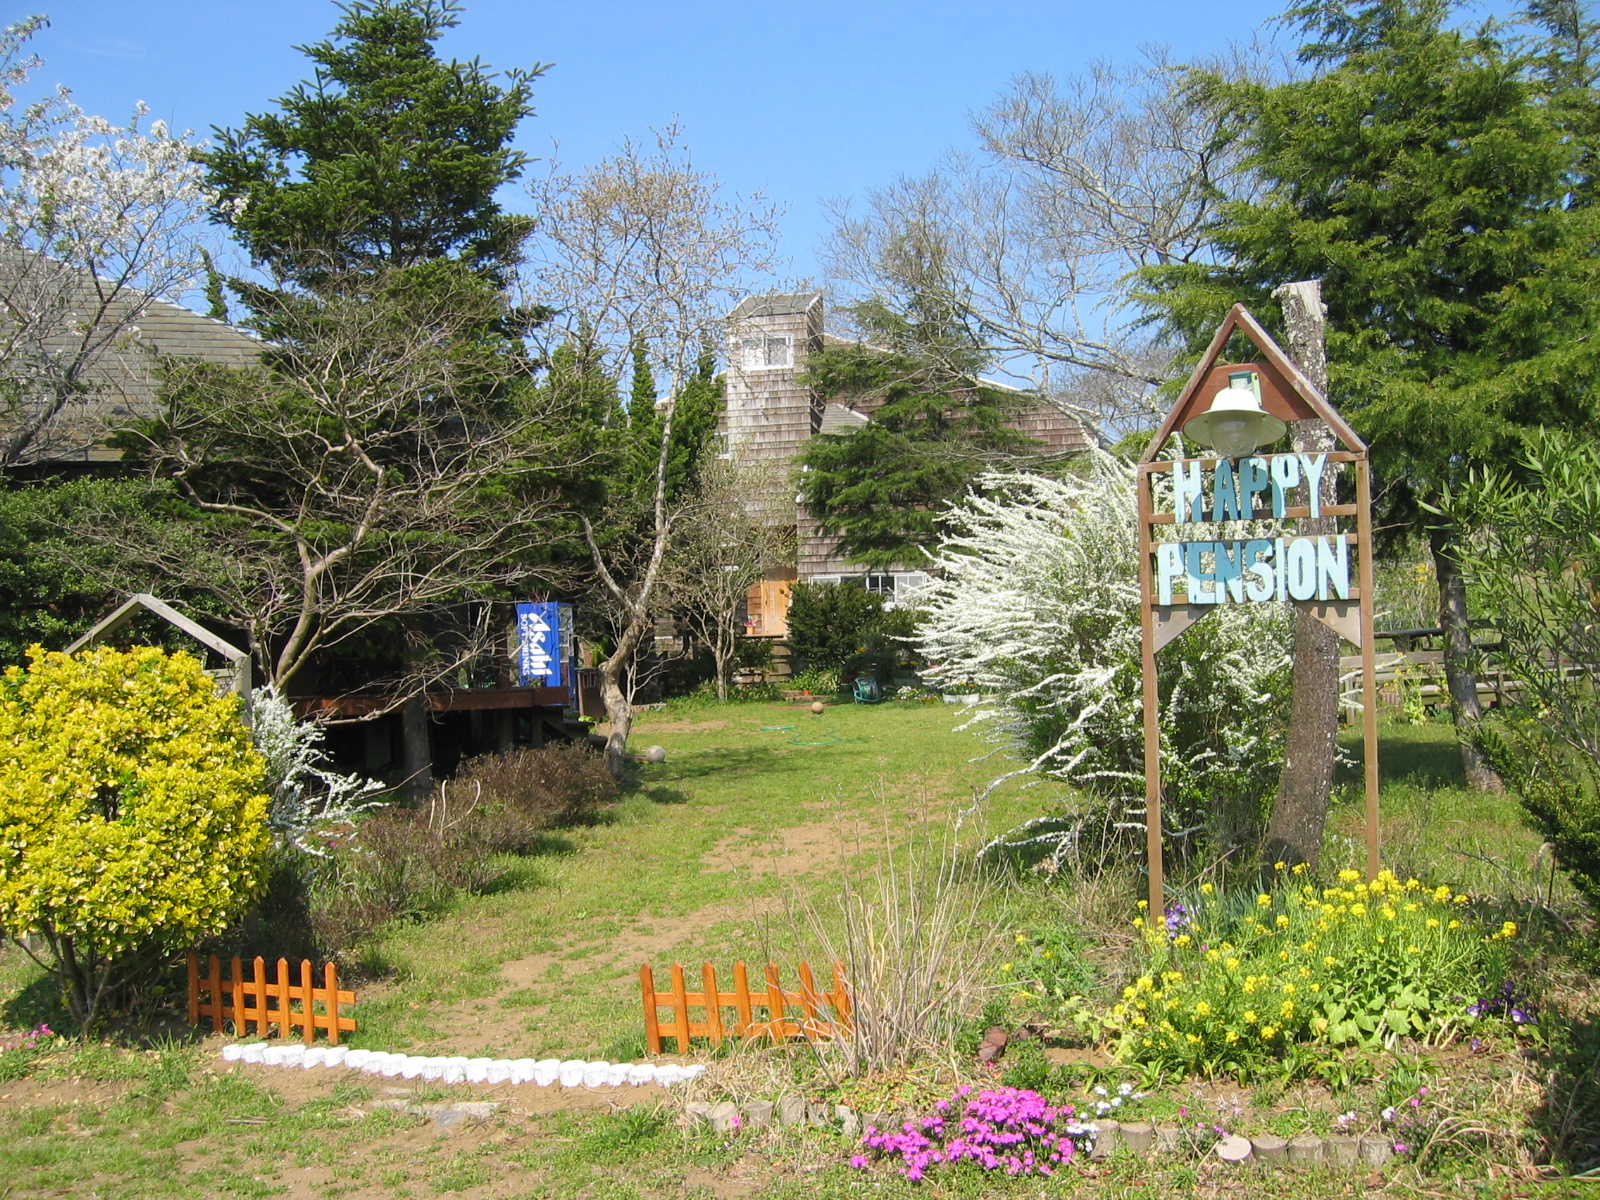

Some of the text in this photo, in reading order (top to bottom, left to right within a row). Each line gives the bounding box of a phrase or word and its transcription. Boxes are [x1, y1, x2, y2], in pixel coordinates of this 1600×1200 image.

[1173, 454, 1327, 523] HAPPY
[1158, 536, 1349, 605] PENSION
[521, 613, 530, 637] SOFT
[528, 613, 553, 675] Asahi
